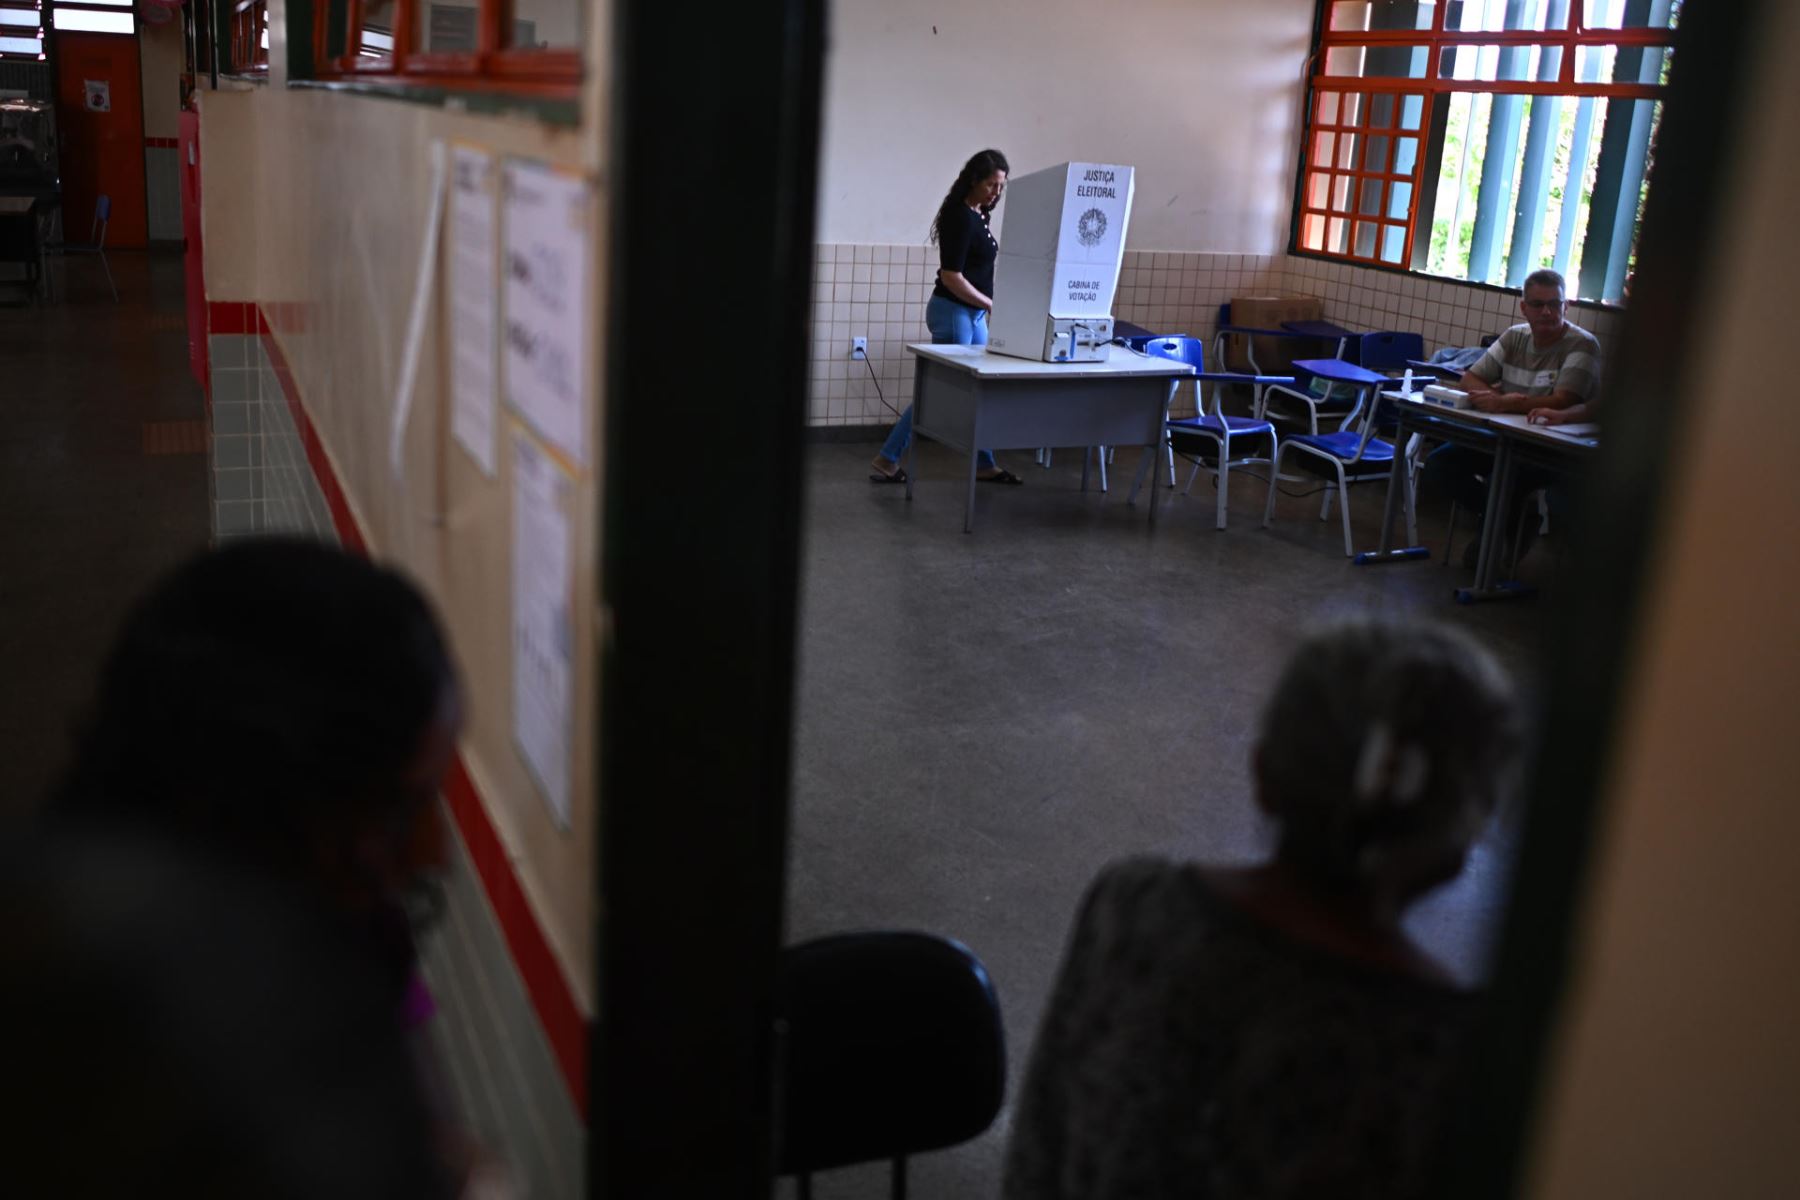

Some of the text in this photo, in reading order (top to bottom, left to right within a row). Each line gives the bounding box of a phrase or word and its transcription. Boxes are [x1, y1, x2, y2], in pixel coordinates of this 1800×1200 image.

[1083, 170, 1115, 185] JUSTIÇA
[1077, 186, 1116, 199] ELEITORAL
[1068, 280, 1100, 290] CABINA DE
[1069, 291, 1096, 302] VOTAÇÃO
